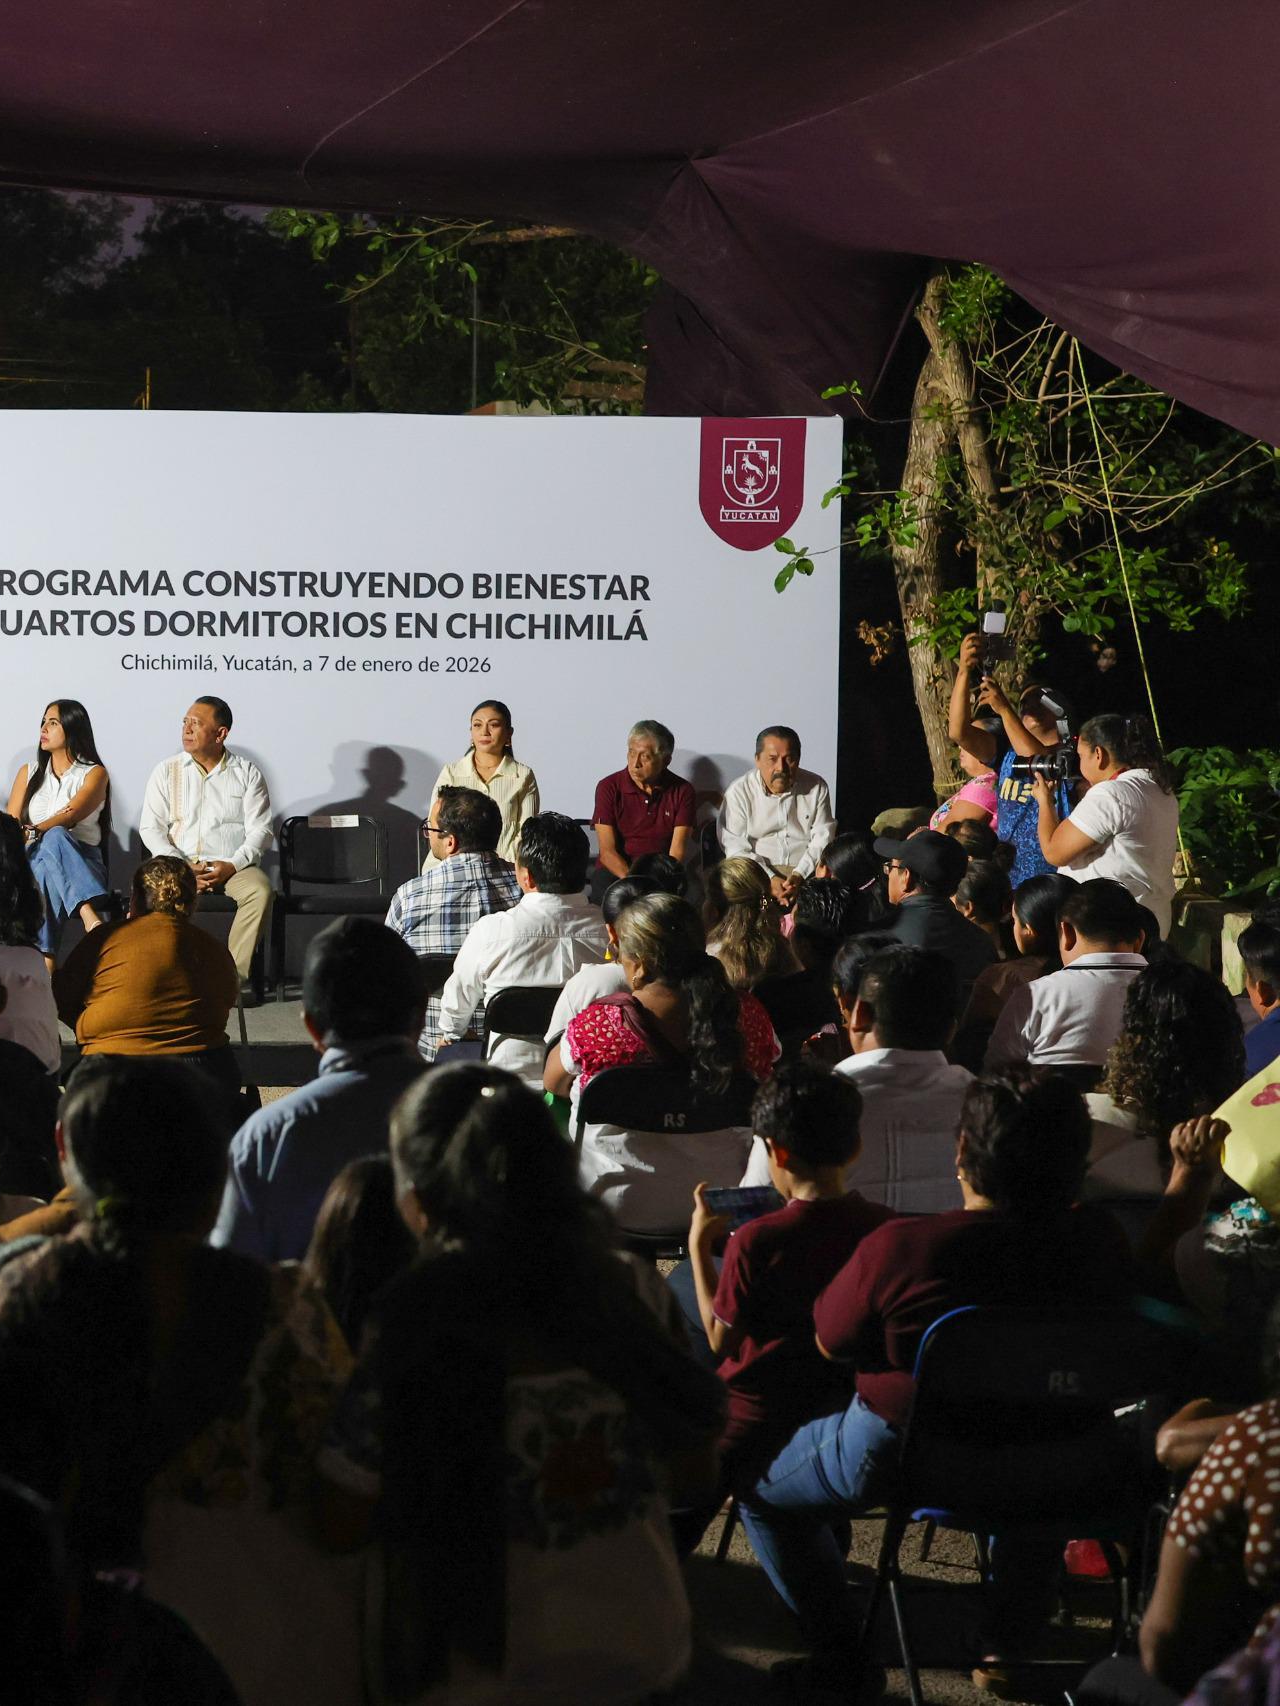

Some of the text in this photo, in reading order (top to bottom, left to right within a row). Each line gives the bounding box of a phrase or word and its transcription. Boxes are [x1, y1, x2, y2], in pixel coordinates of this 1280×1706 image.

[724, 512, 777, 520] YUCATAN
[182, 570, 465, 600] CONSTRUYENDO
[472, 573, 651, 602] BIENESTAR
[144, 610, 388, 639] DORMITORIOS
[395, 612, 438, 639] EN
[445, 608, 649, 642] CHICHIMILÁ
[120, 654, 492, 674] Chichimilá, Yucatán, a 7 de enero de 2026
[663, 1112, 687, 1128] RS
